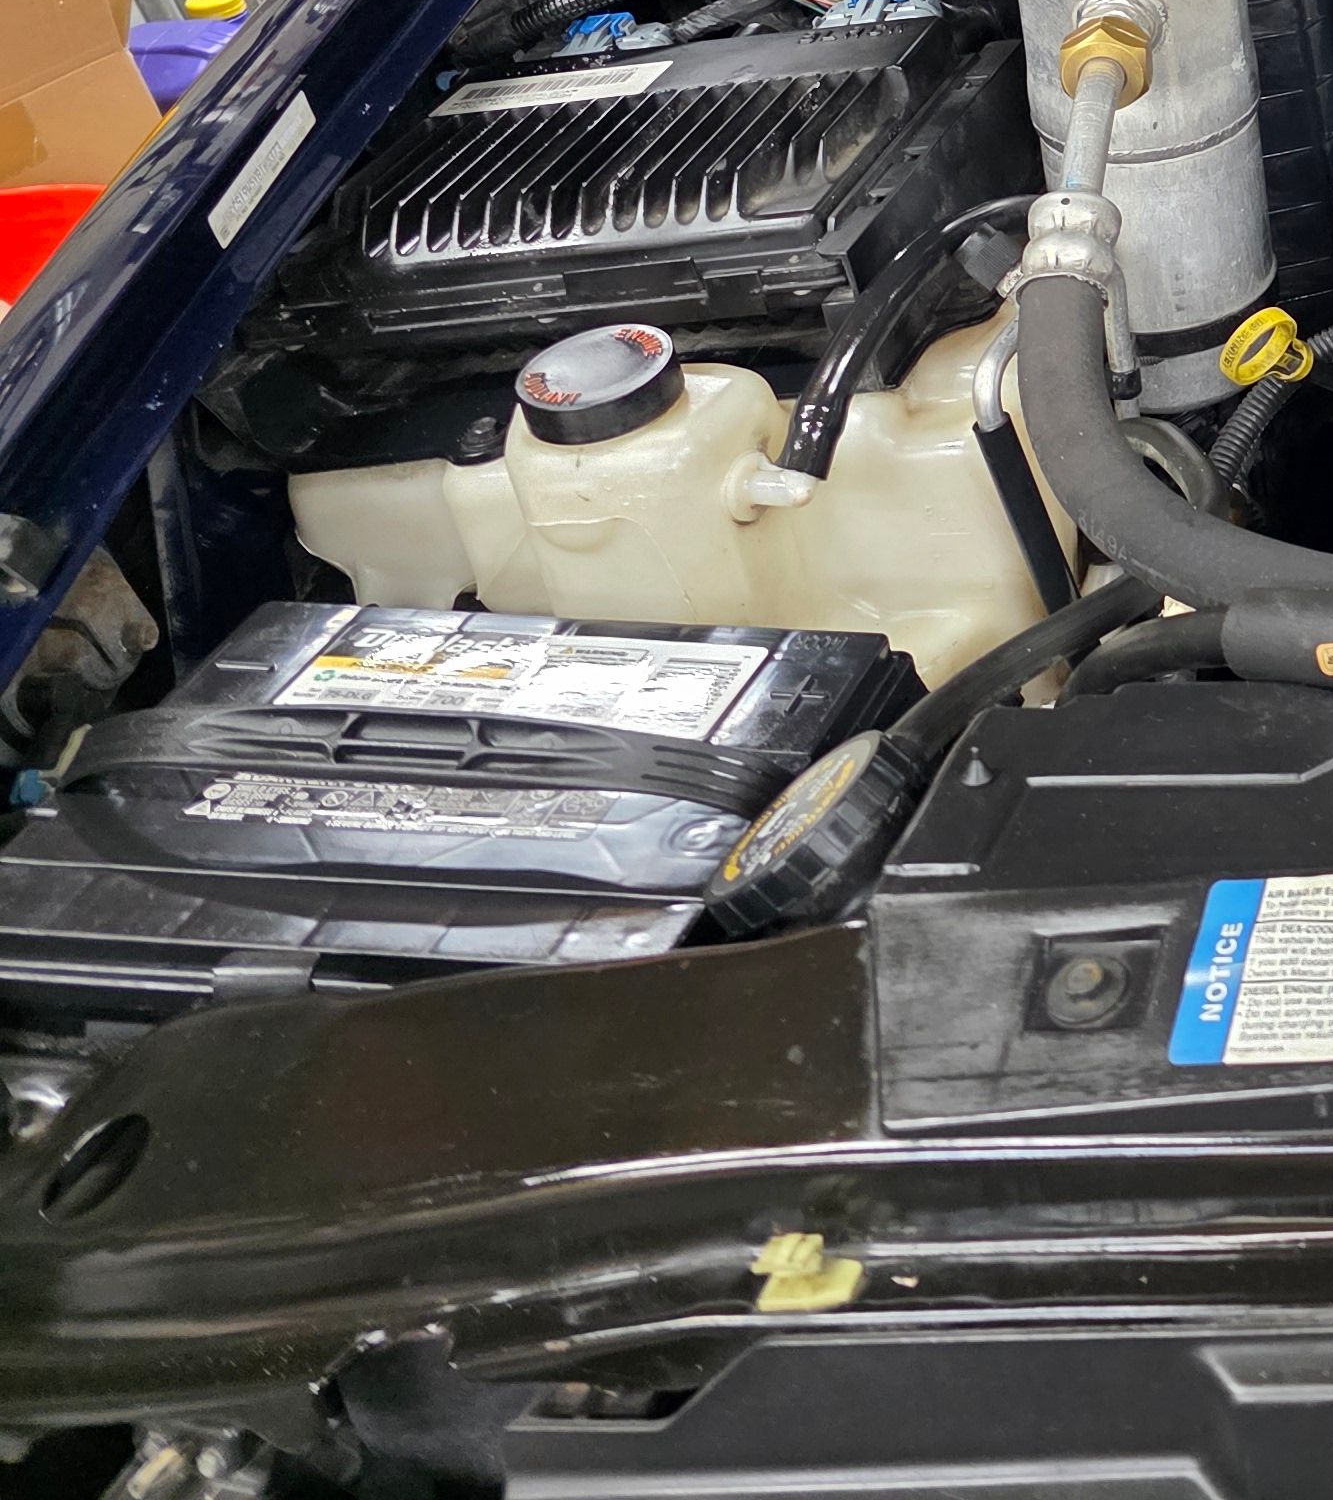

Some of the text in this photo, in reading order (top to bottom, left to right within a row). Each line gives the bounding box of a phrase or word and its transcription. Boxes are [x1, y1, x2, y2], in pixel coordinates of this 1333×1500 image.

[613, 328, 664, 360] ENGINE
[523, 371, 583, 407] COOLANT
[430, 693, 465, 706] 700
[1199, 921, 1244, 1022] NOTICE
